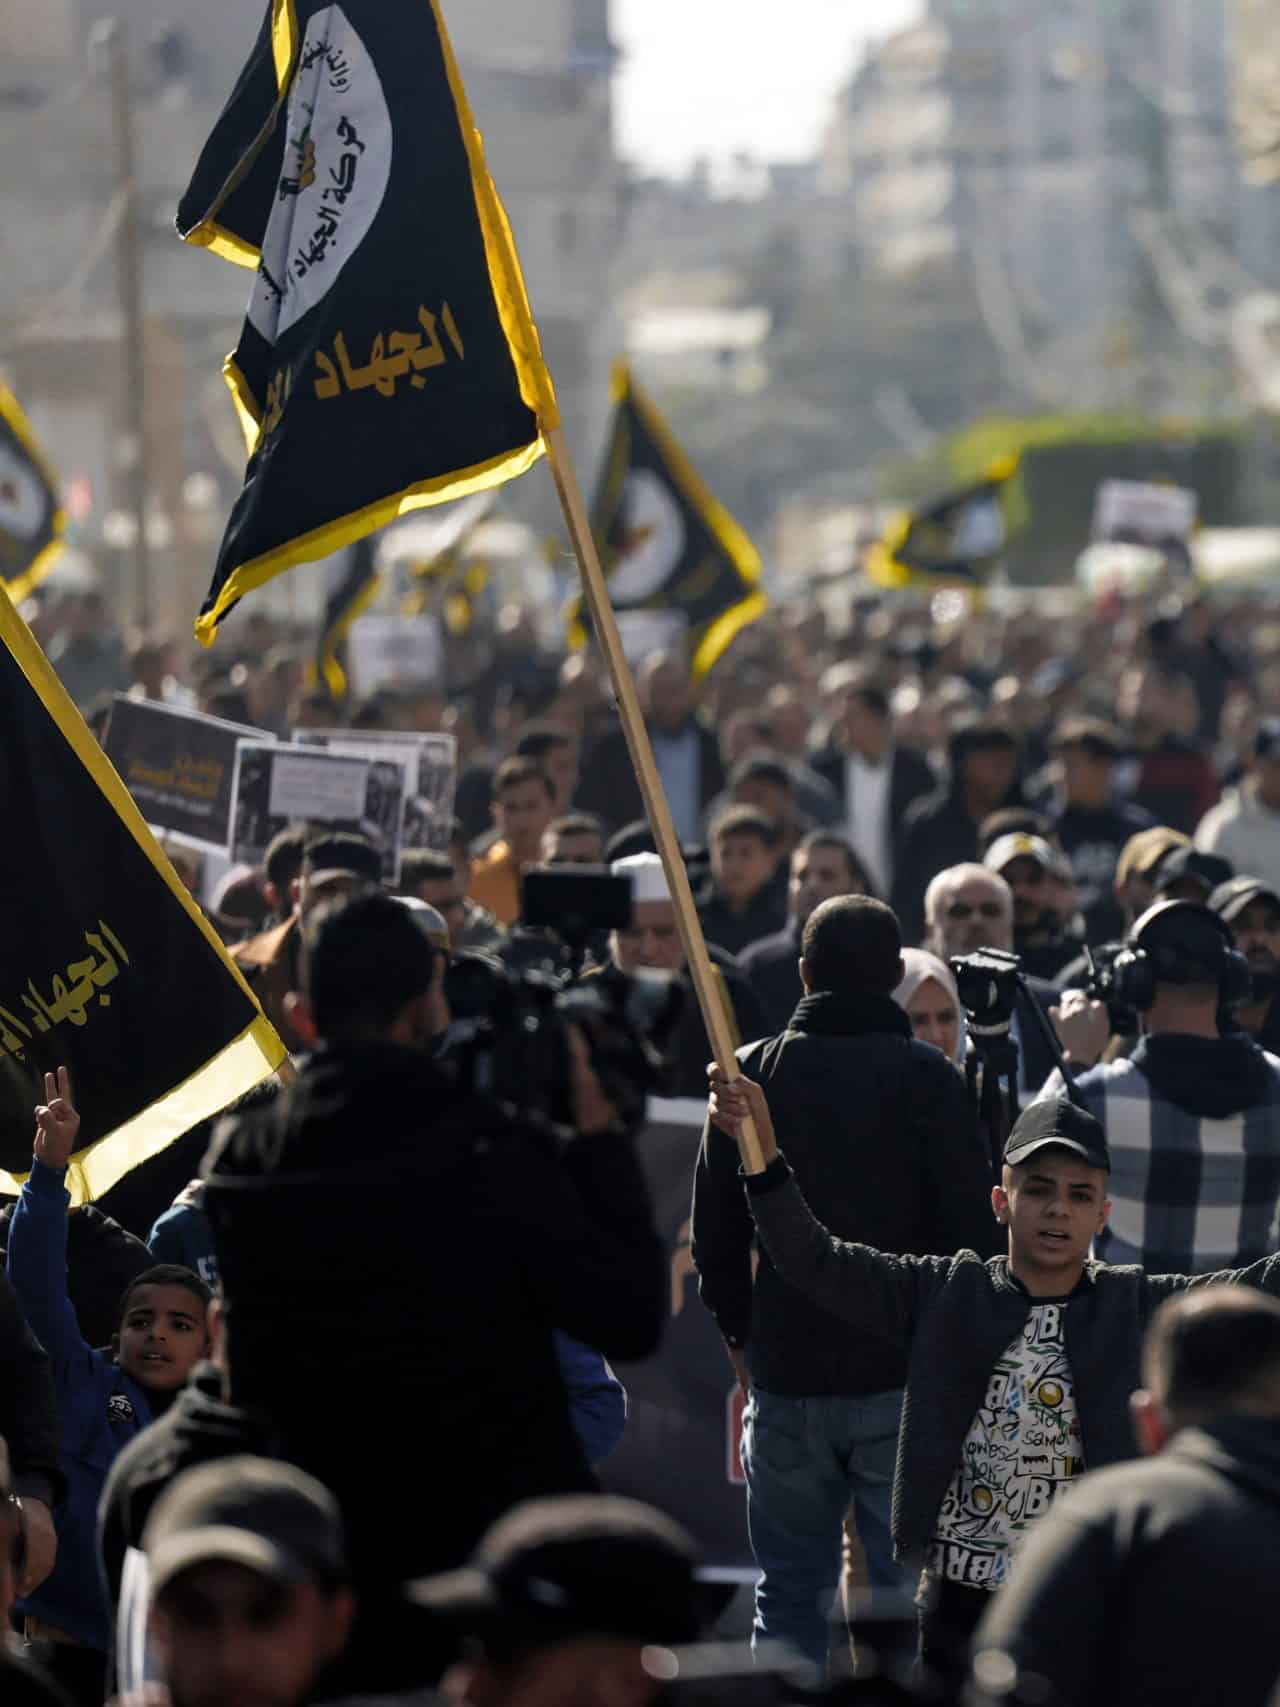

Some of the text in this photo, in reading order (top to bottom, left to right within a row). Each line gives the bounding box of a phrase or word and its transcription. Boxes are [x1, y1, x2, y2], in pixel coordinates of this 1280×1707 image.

[294, 115, 366, 277] حركة الجهاد
[313, 300, 464, 400] الجهاد
[20, 919, 129, 1032] الجهاد
